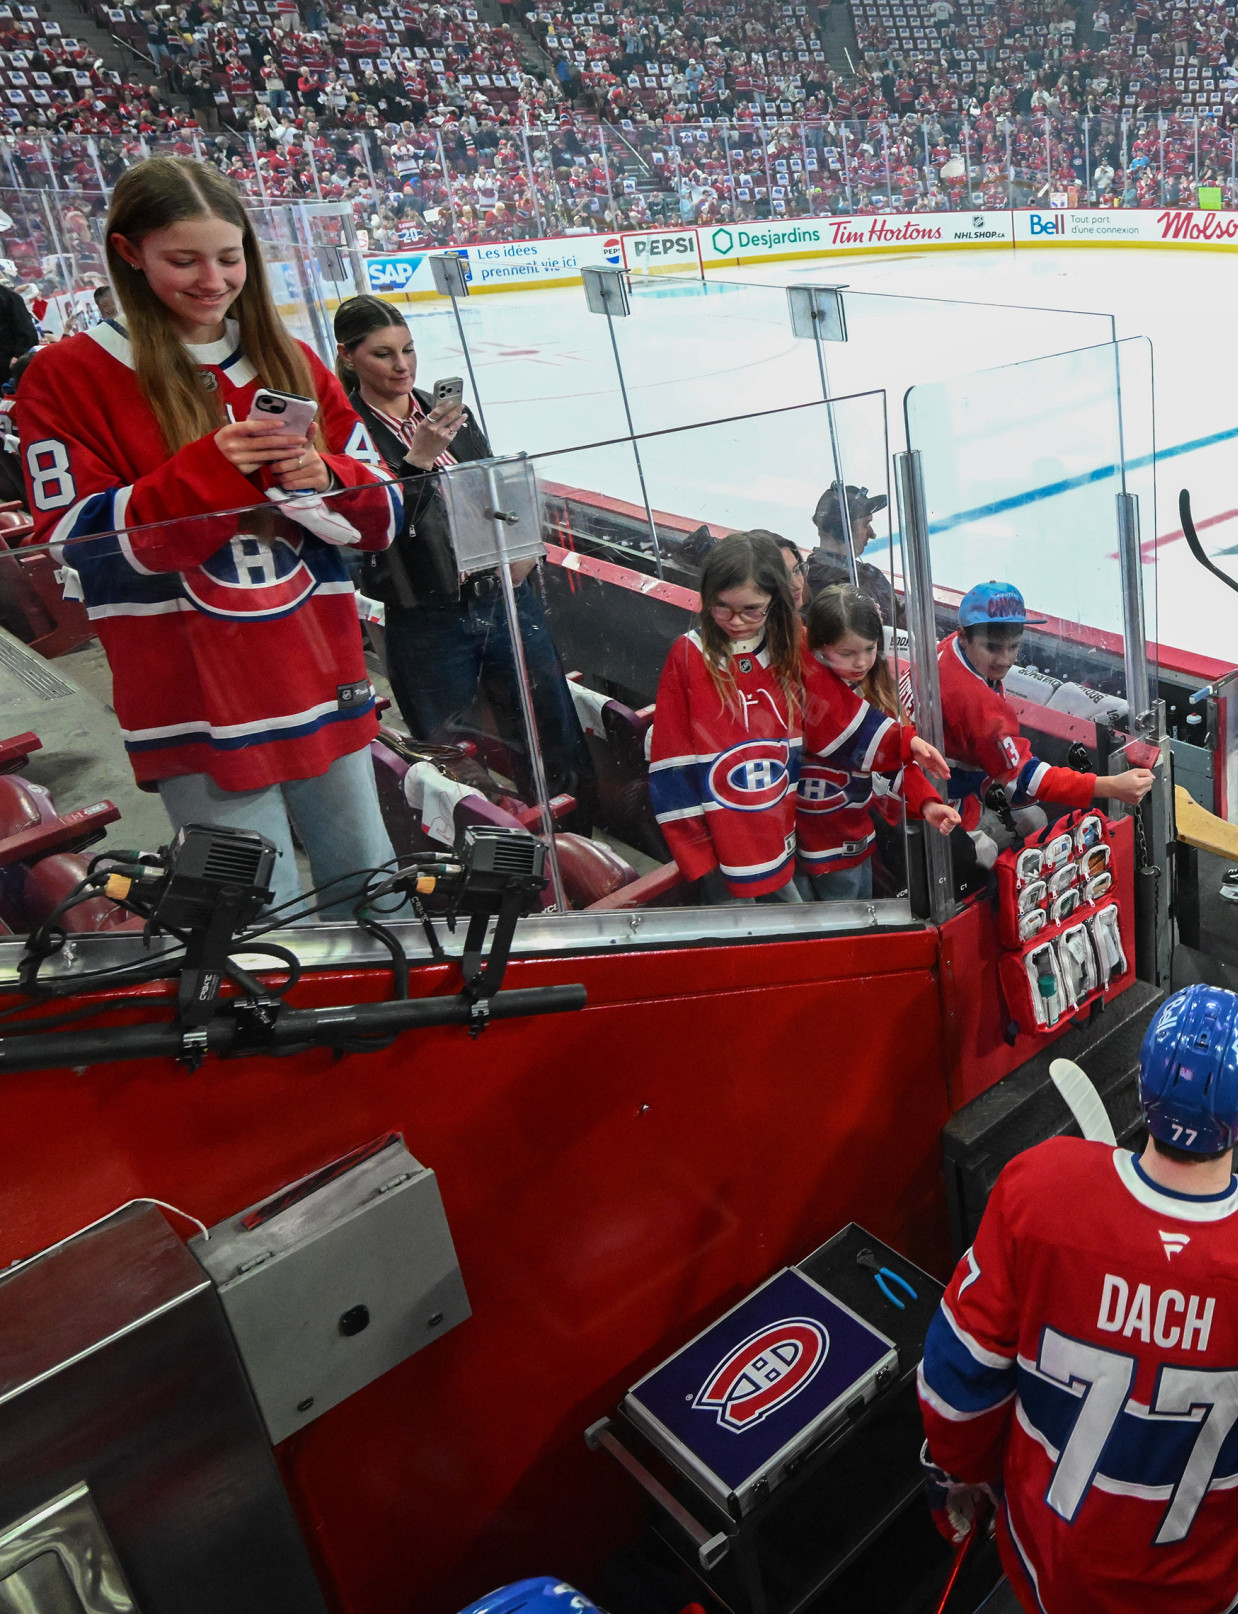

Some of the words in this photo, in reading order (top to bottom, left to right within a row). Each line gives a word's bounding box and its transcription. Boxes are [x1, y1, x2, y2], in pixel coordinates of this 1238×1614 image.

[1030, 214, 1065, 235] Bell
[1070, 215, 1090, 224] Tout
[1092, 216, 1110, 225] part
[1071, 225, 1094, 234] d'une
[1096, 226, 1139, 235] connexion
[738, 228, 820, 249] Desjardins
[829, 221, 864, 245] Tim
[868, 218, 942, 242] Hortons
[478, 245, 500, 260] Les
[503, 243, 538, 258] idées
[634, 236, 695, 257] PEPSI
[562, 255, 578, 268] ici
[368, 263, 413, 286] SAP
[26, 440, 77, 512] 8
[1171, 1123, 1198, 1147] 77
[1096, 1272, 1217, 1352] DACH
